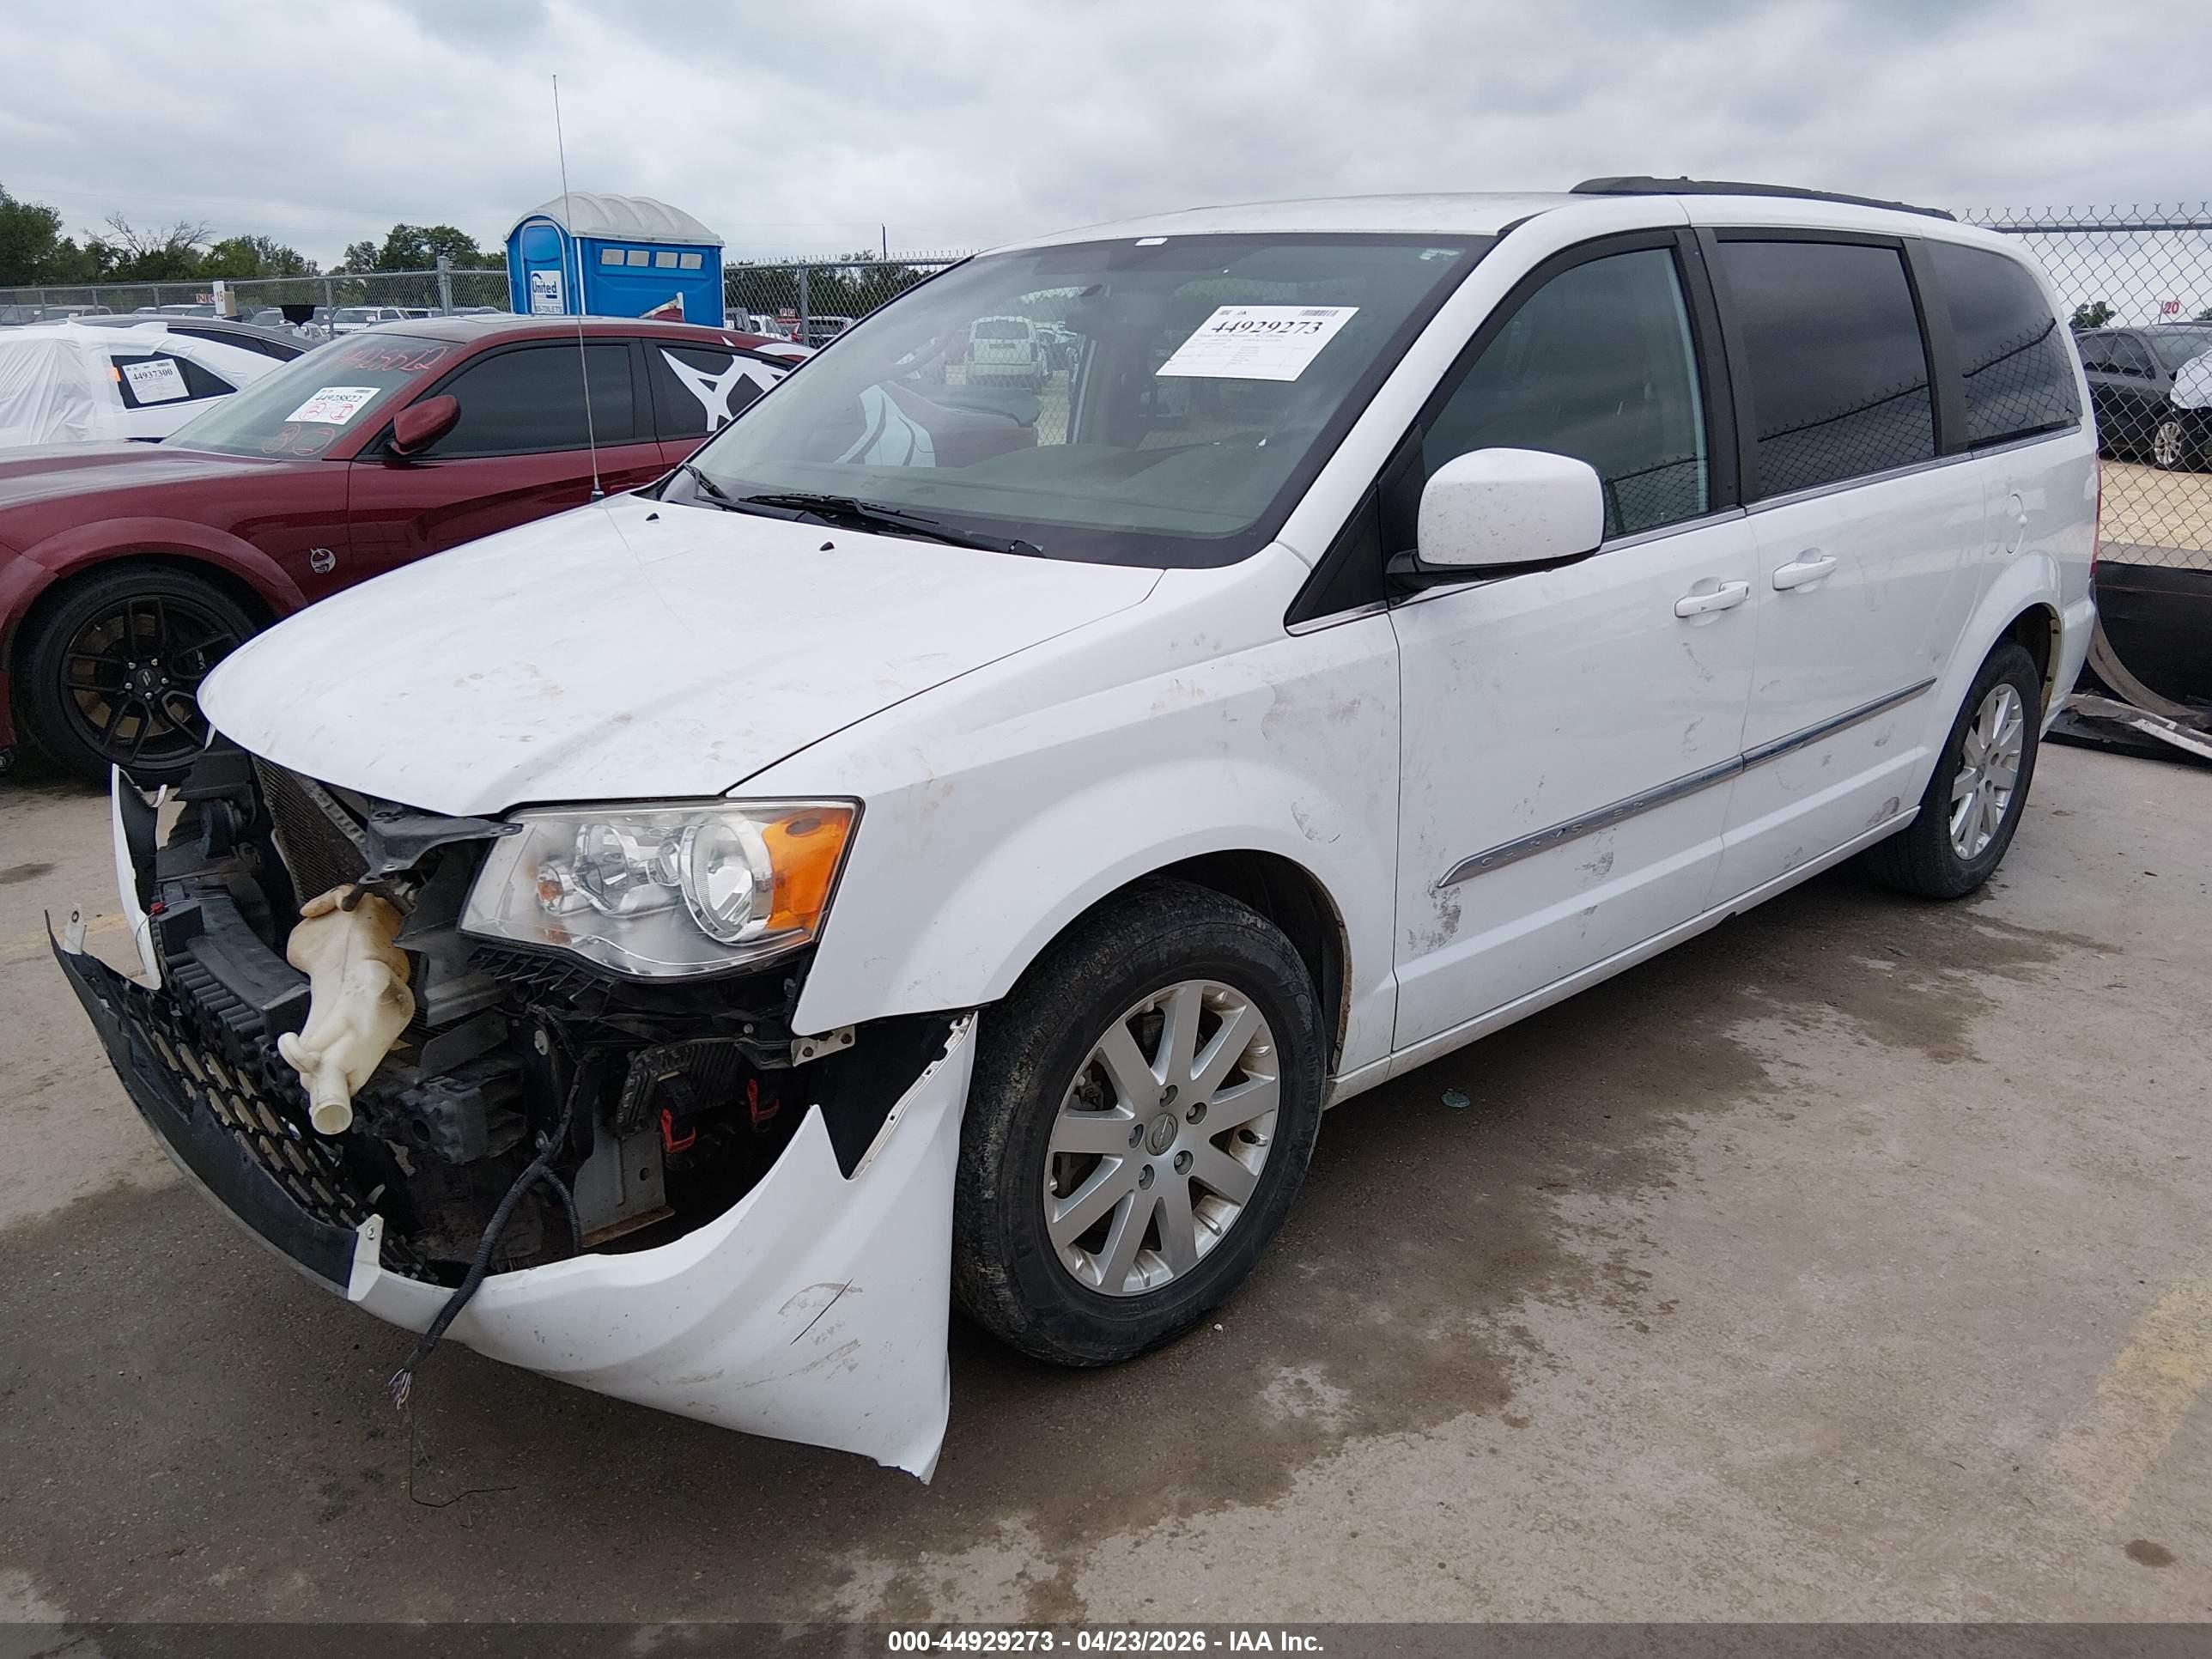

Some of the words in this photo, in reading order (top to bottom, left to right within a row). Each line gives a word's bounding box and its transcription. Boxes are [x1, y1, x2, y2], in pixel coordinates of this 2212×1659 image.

[532, 280, 557, 293] United
[2163, 301, 2179, 314] 20
[1212, 320, 1324, 335] 44929273
[133, 368, 173, 380] 44937300
